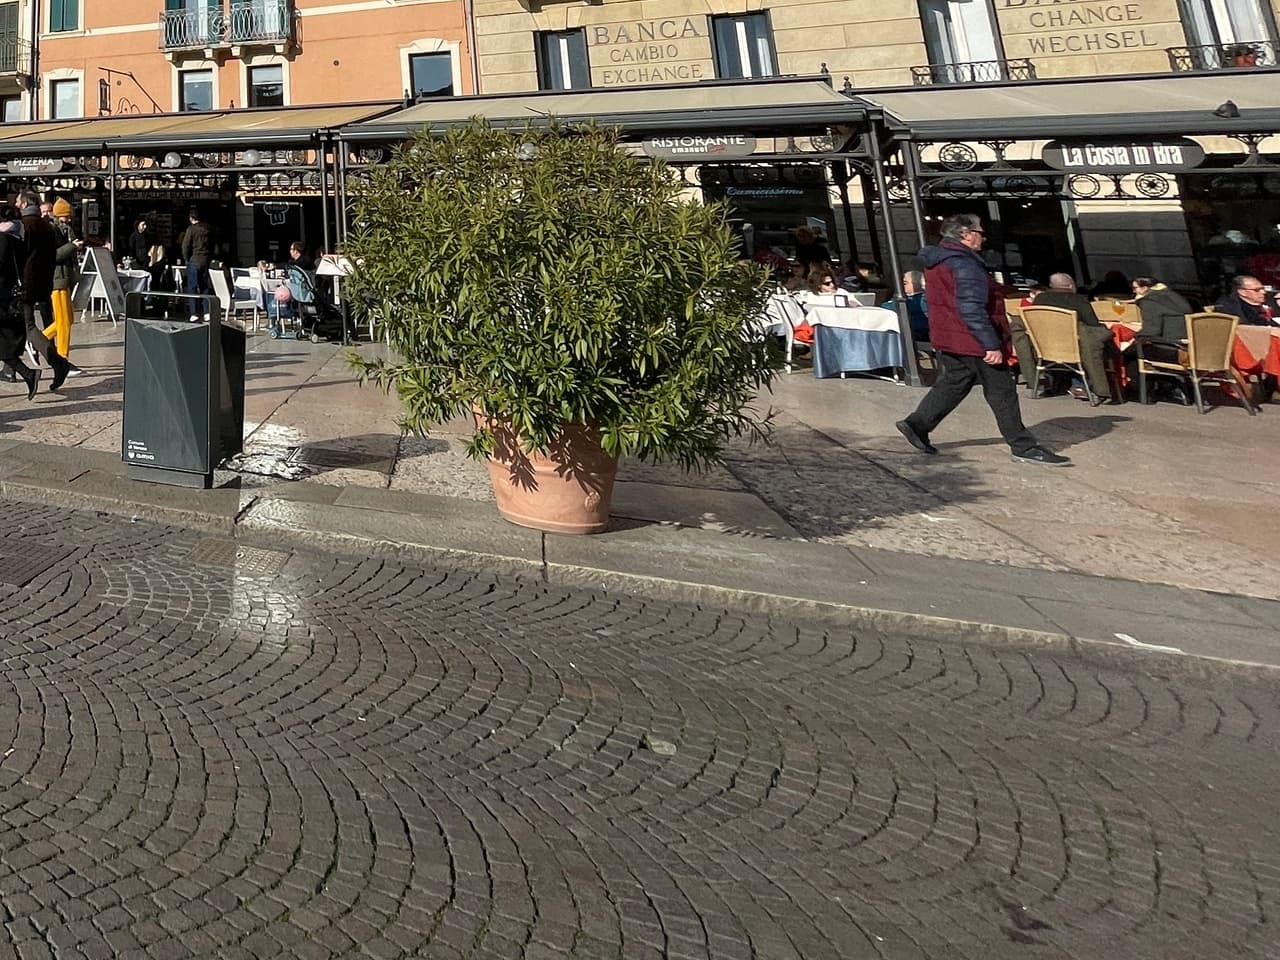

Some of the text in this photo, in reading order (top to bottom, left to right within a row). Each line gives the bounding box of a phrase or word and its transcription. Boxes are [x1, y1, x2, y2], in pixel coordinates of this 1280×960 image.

[1029, 3, 1143, 28] CHANGE
[593, 18, 700, 46] BANCA
[1028, 30, 1158, 54] WECHSEL
[610, 44, 678, 62] CAMBIO
[603, 64, 703, 84] EXCHANGE
[652, 135, 746, 148] RISTORANTE
[13, 156, 55, 167] PIZZERIA
[1061, 143, 1084, 166] La
[1131, 142, 1151, 165] in
[1153, 142, 1184, 165] Bra
